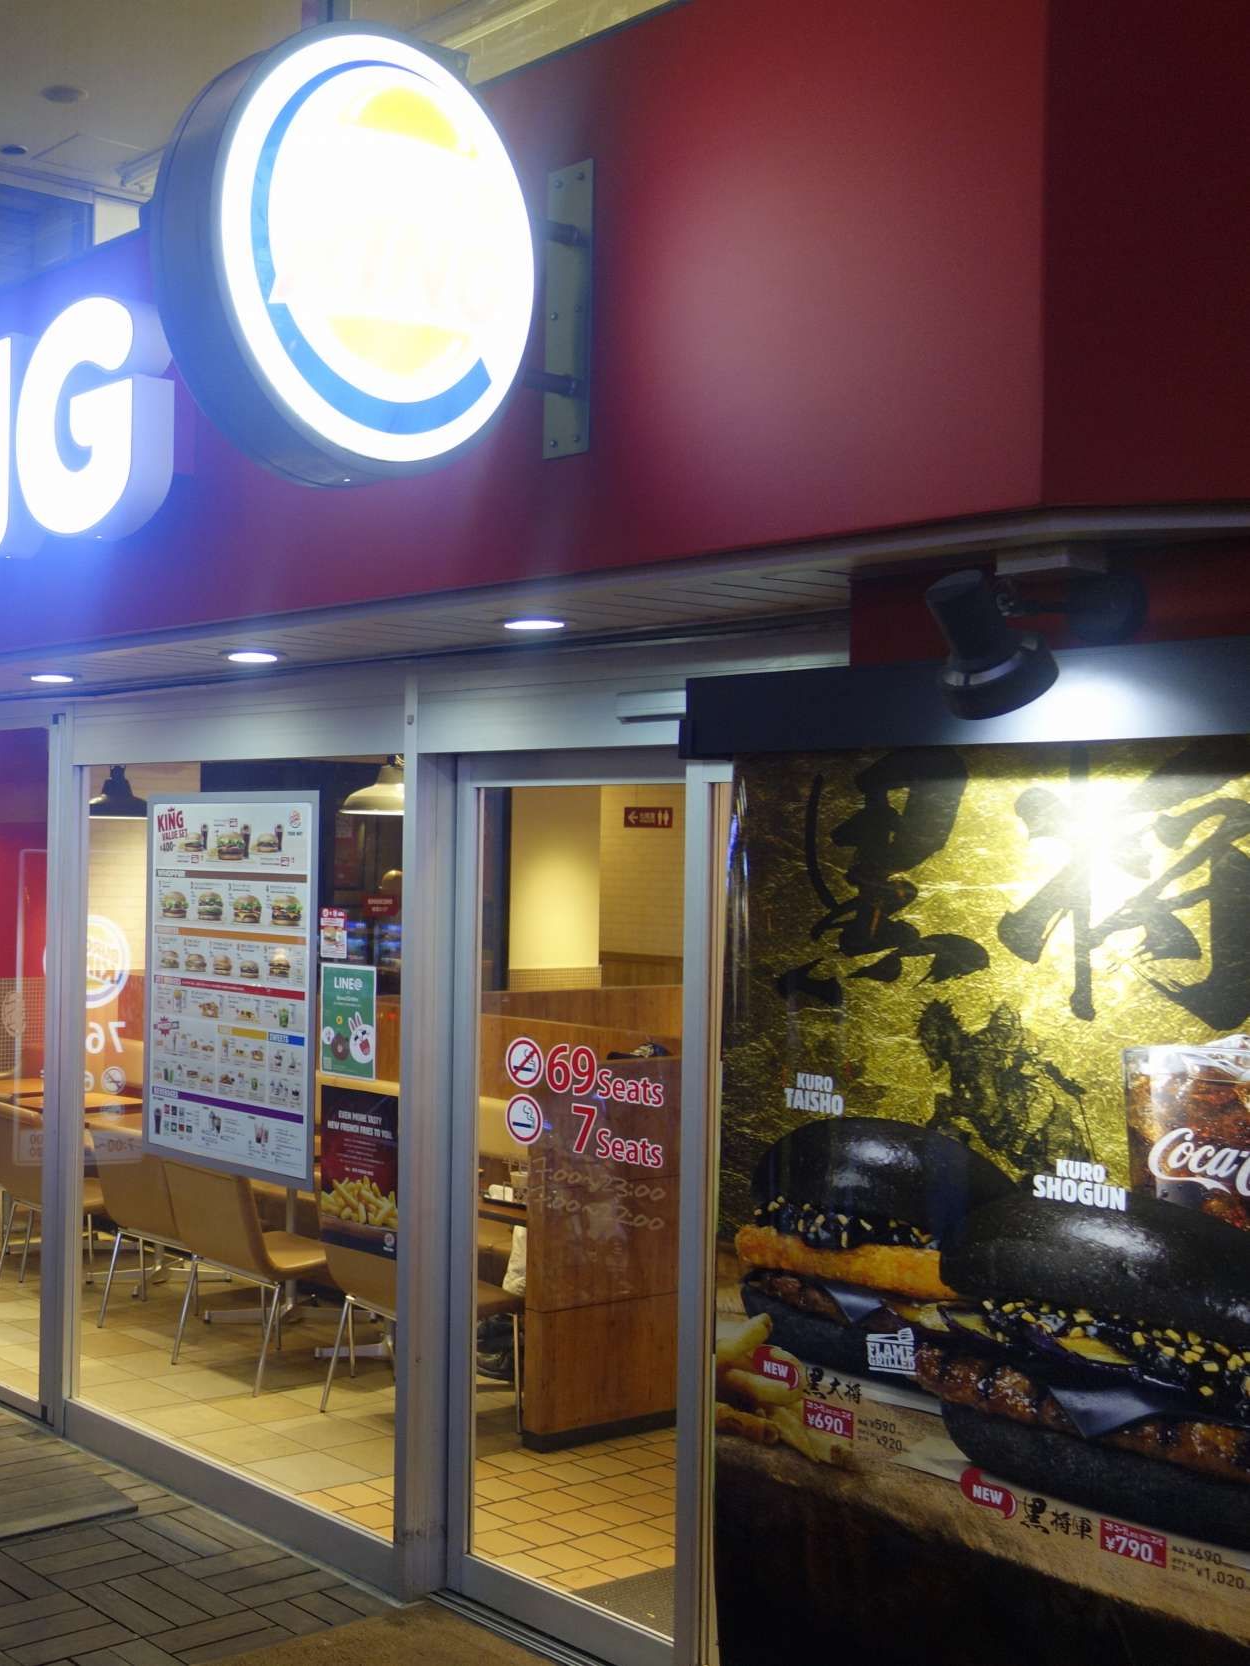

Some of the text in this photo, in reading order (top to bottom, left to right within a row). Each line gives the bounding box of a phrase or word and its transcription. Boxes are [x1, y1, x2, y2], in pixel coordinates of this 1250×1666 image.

[157, 810, 184, 833] KING
[546, 1043, 664, 1108] 69 Seats
[796, 1072, 833, 1093] KURO
[784, 1087, 844, 1116] TAISHO
[571, 1103, 663, 1169] 7 Seats
[1056, 1159, 1105, 1184] KURO
[1033, 1174, 1127, 1212] SHOGUN
[763, 1360, 789, 1379] NEW
[806, 1412, 844, 1435] ¥690
[972, 1483, 1004, 1506] NEW
[1104, 1534, 1153, 1563] ¥790
